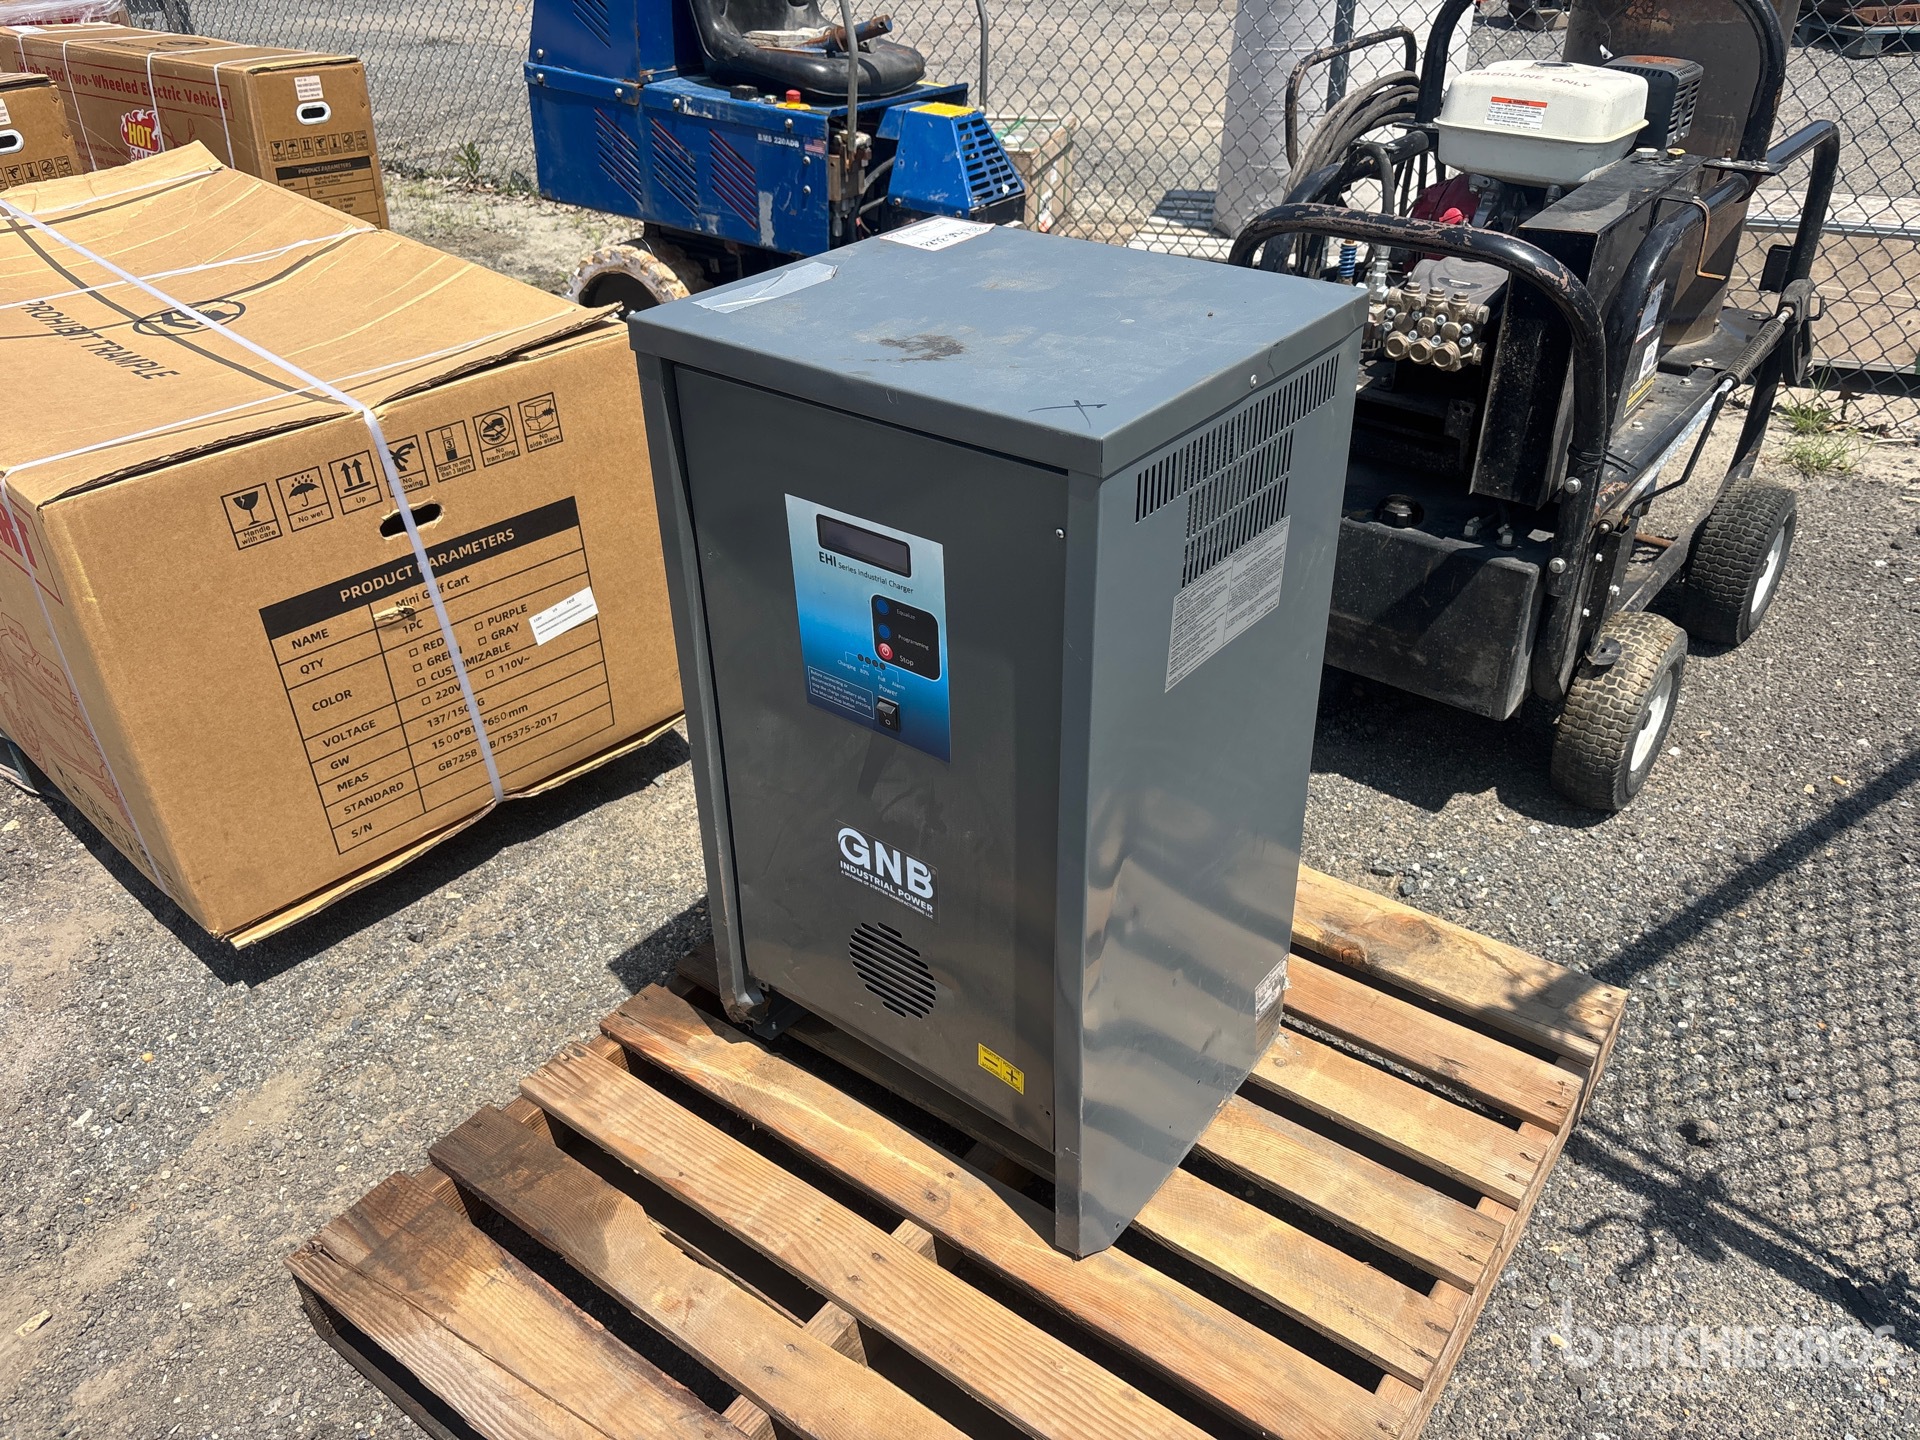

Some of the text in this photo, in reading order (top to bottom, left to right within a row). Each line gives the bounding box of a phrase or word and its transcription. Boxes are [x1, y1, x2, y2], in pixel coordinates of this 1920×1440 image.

[1470, 72, 1592, 88] GASOLINE ONLY
[128, 122, 152, 149] HOT
[21, 300, 181, 380] PROHIBIT TRAMPLE
[529, 435, 560, 449] side stack
[538, 432, 549, 440] No
[495, 446, 505, 455] No
[438, 464, 451, 473] Stack
[459, 458, 471, 467] more
[457, 465, 471, 474] layers
[355, 495, 367, 505] Up
[298, 510, 324, 523] No wet
[242, 529, 276, 545] with care
[243, 525, 271, 538] Handle
[339, 528, 515, 602] PRODUCT ARAMETERS
[818, 551, 913, 594] EHI Series Industrial Charger
[395, 574, 470, 608] Mini Glf Cart
[566, 597, 576, 605] red
[896, 608, 916, 620] Equalize
[402, 619, 424, 634] 1PC
[423, 637, 445, 652] RED
[487, 604, 528, 626] PURPLE
[490, 622, 520, 641] GRAY
[291, 628, 330, 650] NAME
[898, 634, 930, 651] Programming
[299, 658, 325, 675] QTY
[430, 642, 512, 681] CUSTMIZABLE
[499, 655, 531, 673] 110V~
[837, 659, 857, 672] Charging
[899, 655, 914, 667] Stop
[860, 668, 870, 677] 80%
[878, 684, 898, 697] Power
[891, 681, 906, 691] Alarm
[312, 689, 353, 712] COLOR
[427, 697, 485, 728] 137/150G
[322, 719, 377, 748] VOLTAGE
[438, 712, 559, 772] GB7258 B/T5375-2017
[330, 755, 350, 770] GW
[336, 772, 370, 793] MEAS
[343, 781, 404, 815] STANDARD
[351, 822, 373, 839] S/N
[837, 827, 934, 899] GNB
[840, 860, 933, 913] INDUSTRIAL POWER
